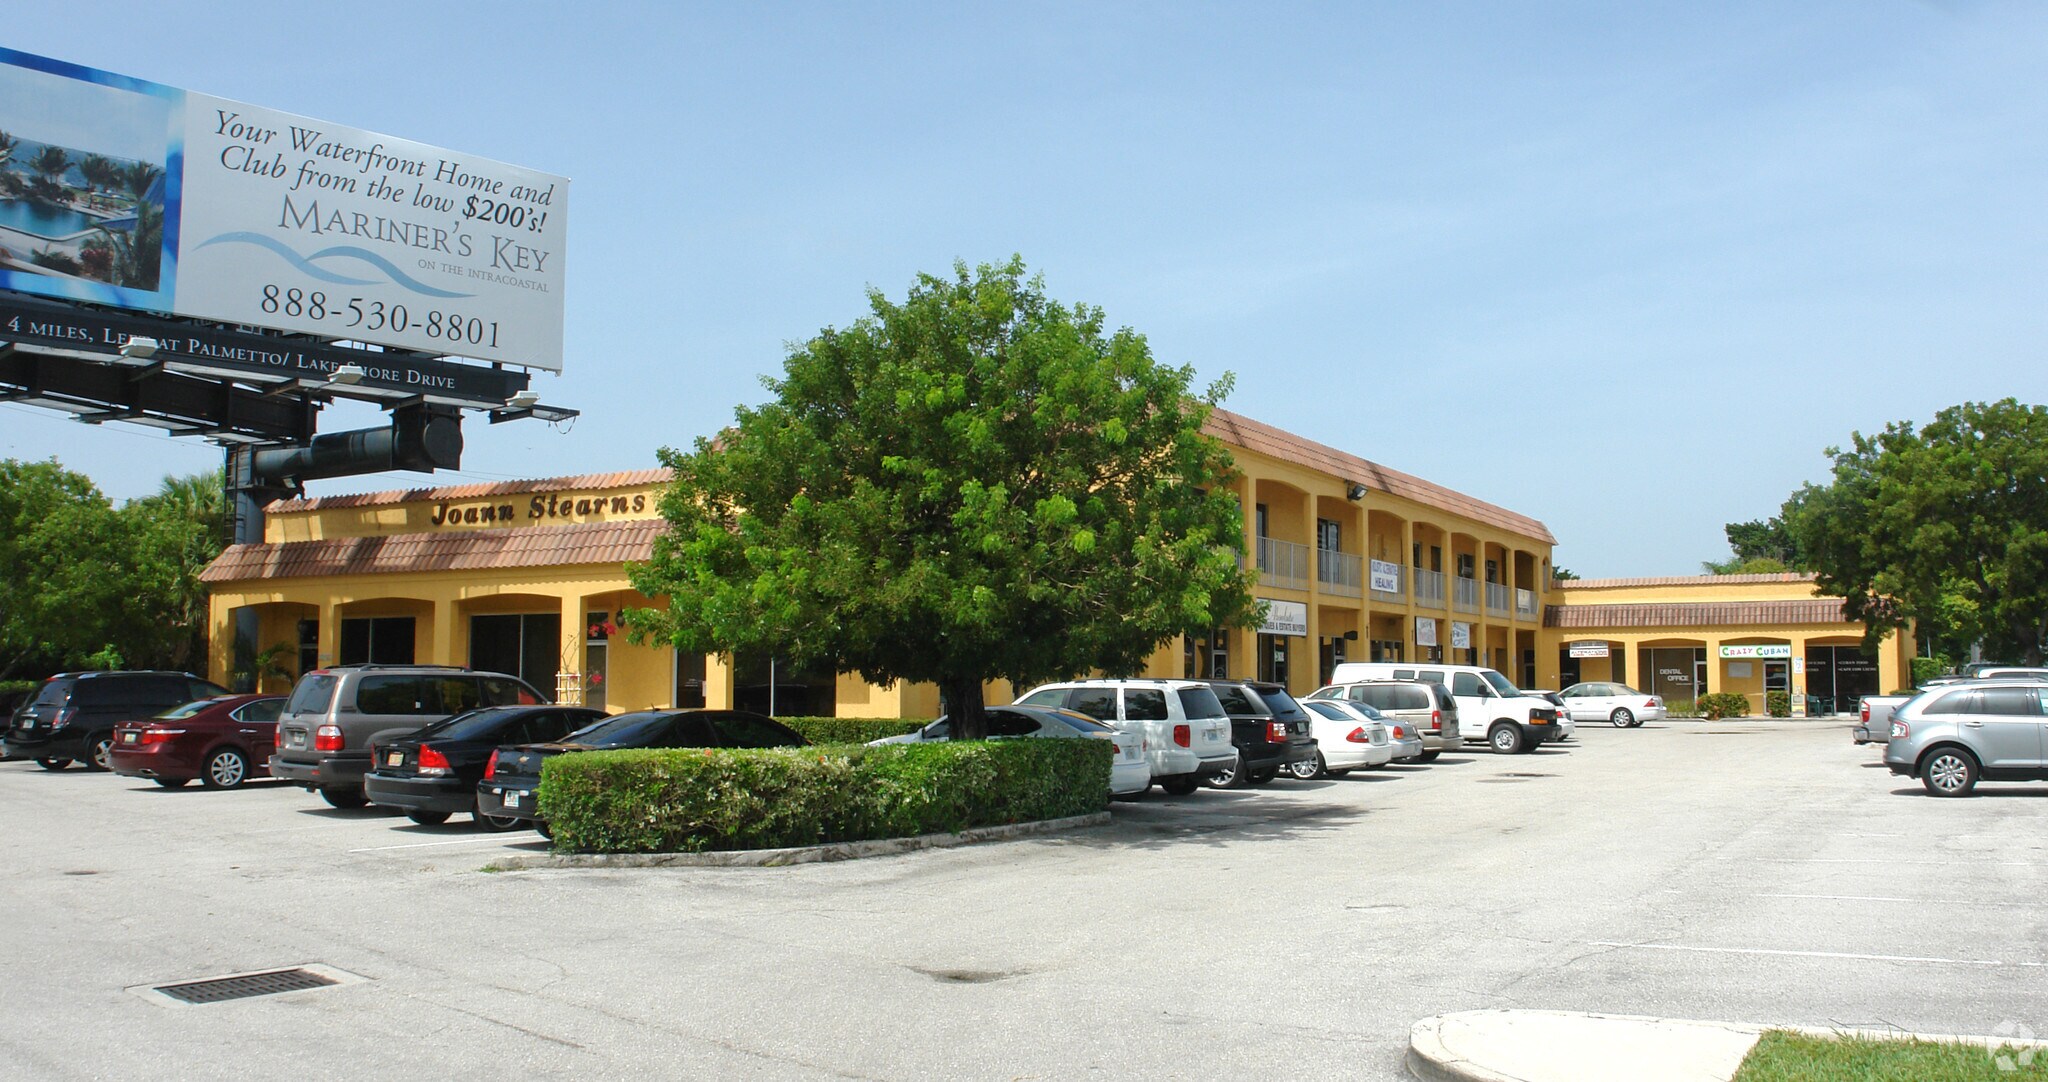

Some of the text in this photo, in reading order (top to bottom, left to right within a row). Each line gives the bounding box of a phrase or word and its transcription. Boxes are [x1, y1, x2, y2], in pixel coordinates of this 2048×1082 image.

[215, 109, 554, 206] Your Waterfront Home and
[220, 145, 547, 233] Club from the low $200's!
[278, 193, 550, 273] MARINER'S KEY
[418, 258, 550, 293] ON THE INTRACOASTAL
[261, 284, 499, 348] 888-530-8801
[8, 315, 20, 332] 4
[29, 321, 94, 343] MILES,
[103, 328, 151, 345] LE
[158, 338, 180, 351] AT
[188, 338, 290, 367] PALMETTO/
[297, 353, 339, 373] LAKE
[406, 369, 455, 389] DRIVE
[432, 491, 646, 525] Joann Stearns
[1756, 647, 1788, 656] CUBAN
